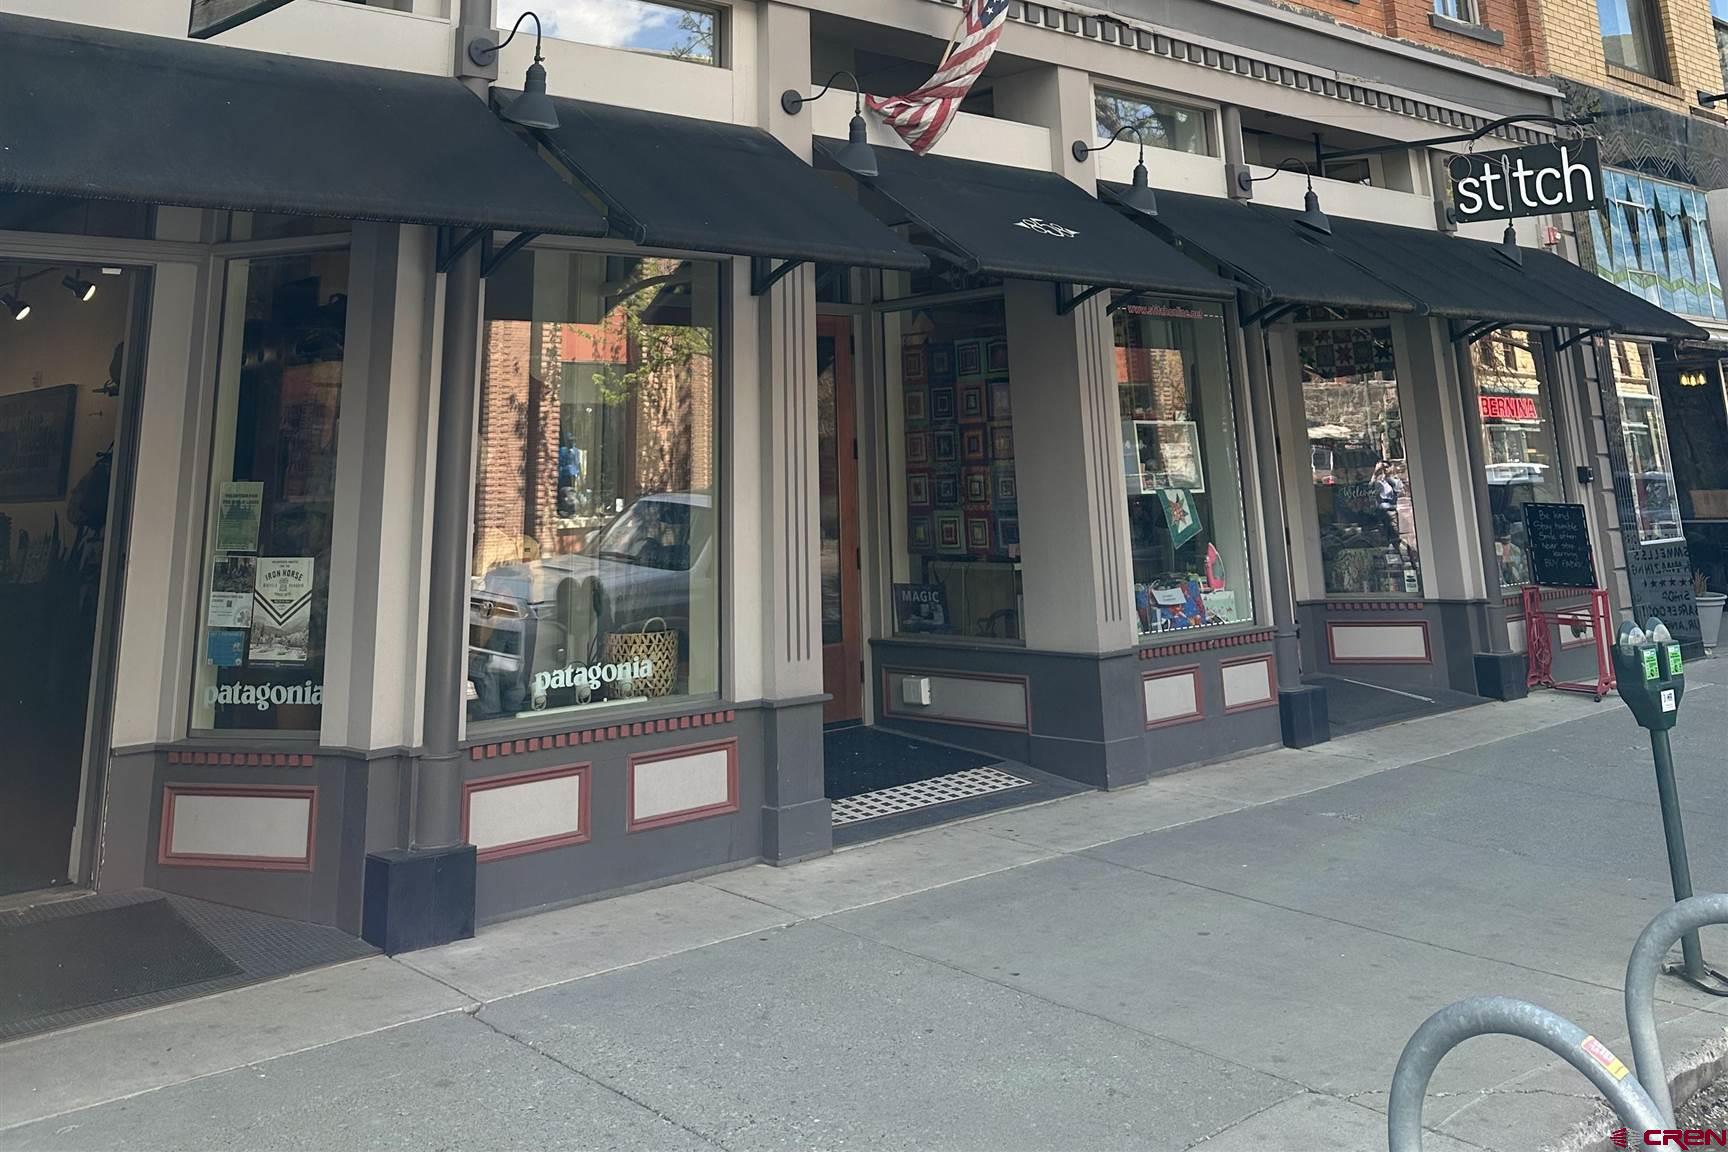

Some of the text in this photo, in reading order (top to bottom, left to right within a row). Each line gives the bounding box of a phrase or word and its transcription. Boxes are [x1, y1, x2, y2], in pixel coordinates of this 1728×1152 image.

[1457, 146, 1595, 215] stitch
[1479, 397, 1538, 417] BERNINA
[264, 569, 304, 582] IRON HORSE
[902, 590, 940, 603] MAGIC
[535, 655, 654, 696] patagonia
[204, 680, 323, 711] patagonia
